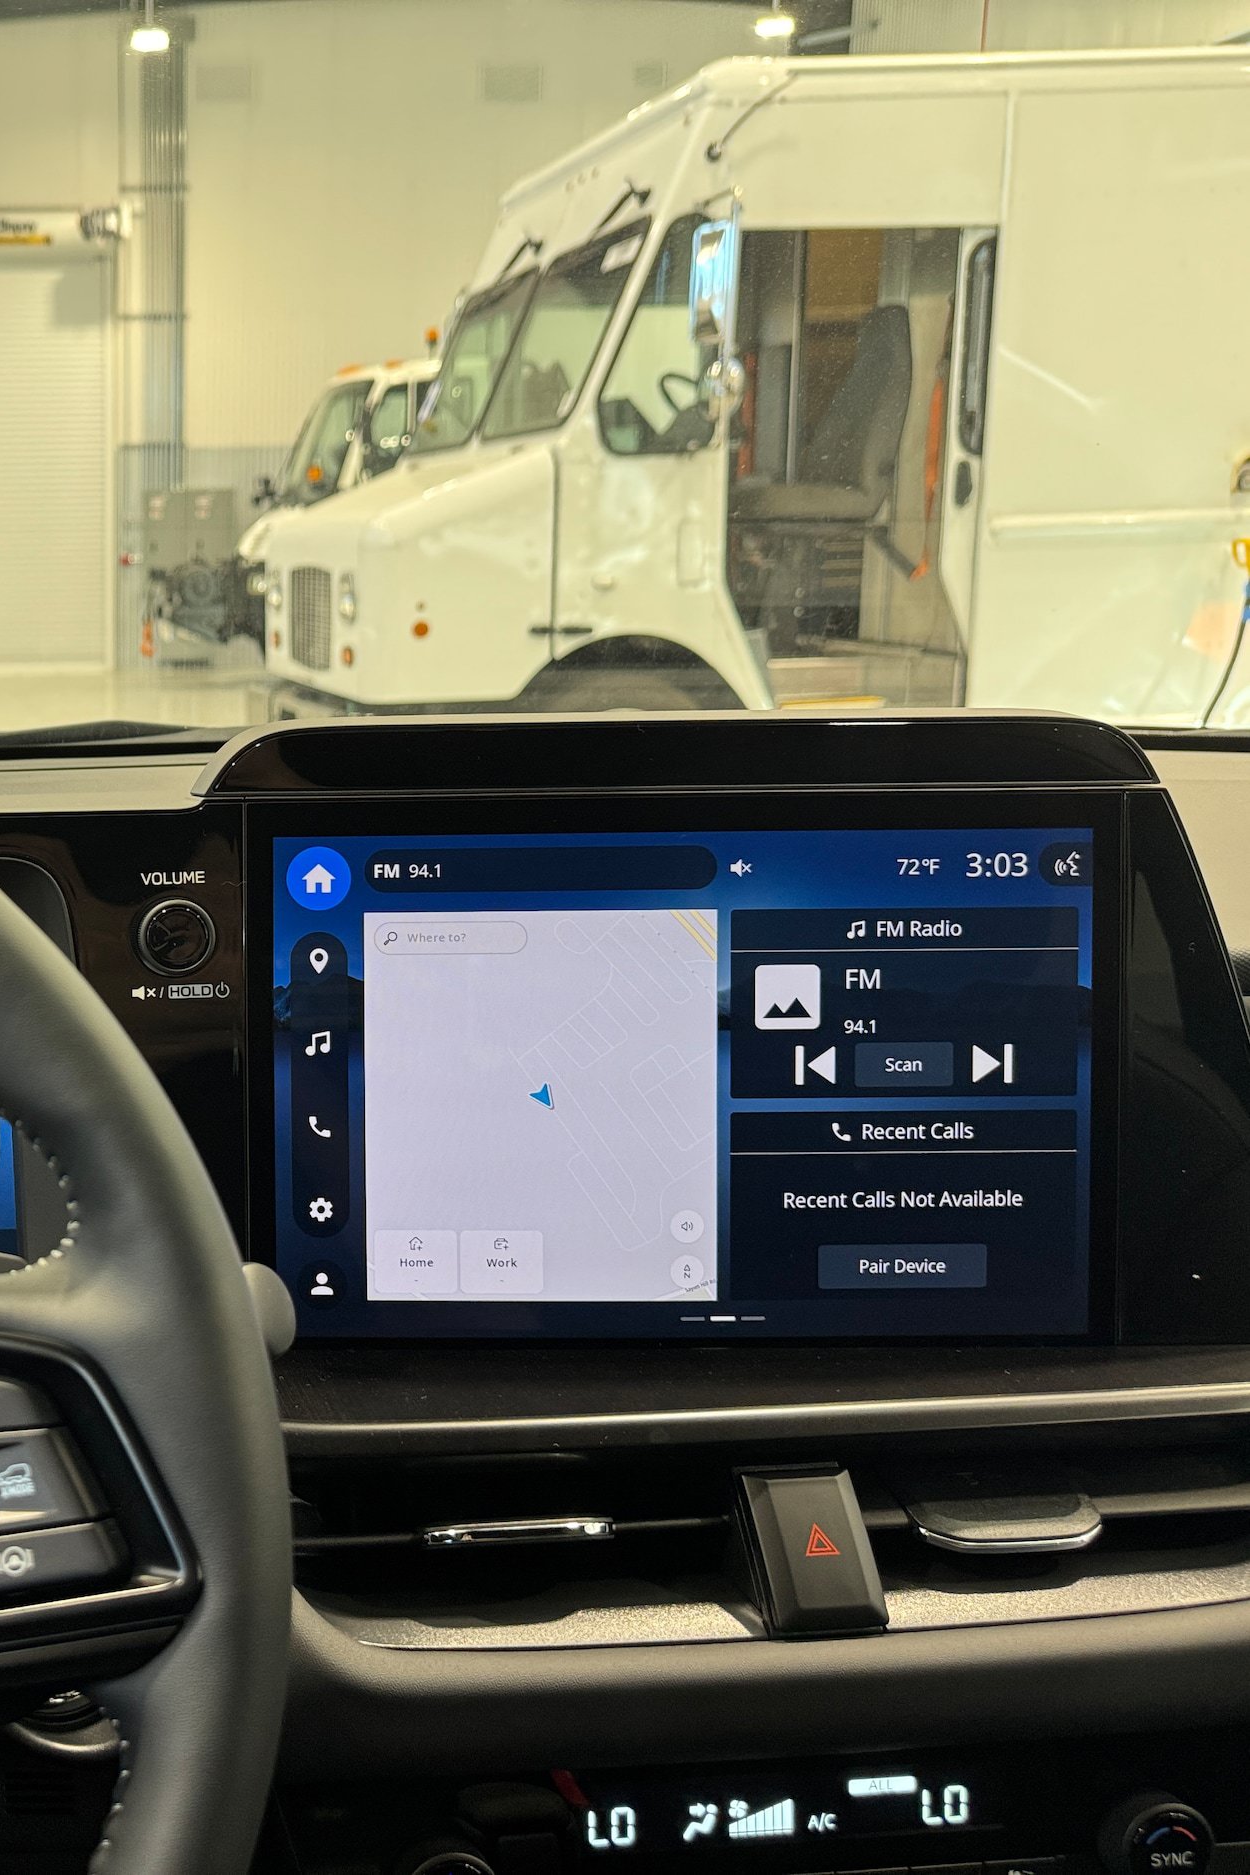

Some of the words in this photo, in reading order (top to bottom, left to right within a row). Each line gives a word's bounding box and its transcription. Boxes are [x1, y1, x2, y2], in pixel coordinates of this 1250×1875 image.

[374, 863, 400, 878] FM
[408, 863, 442, 879] 94.1
[896, 858, 941, 876] 72°F
[965, 852, 1029, 878] 3:03
[140, 870, 206, 886] VOLUME
[876, 921, 904, 938] FM
[910, 920, 963, 938] Radio
[406, 932, 445, 944] Where
[449, 932, 467, 943] to?
[845, 968, 882, 991] FM
[169, 985, 212, 998] HOLD
[843, 1019, 877, 1035] 94.1
[884, 1057, 923, 1073] Scan
[861, 1123, 927, 1140] Recent
[930, 1121, 975, 1140] Calls
[783, 1192, 848, 1209] Recent
[851, 1190, 896, 1209] Calls
[900, 1191, 936, 1209] Not
[938, 1189, 1024, 1208] Available
[399, 1257, 434, 1269] Home
[486, 1257, 518, 1269] Work
[858, 1259, 890, 1275] Pair
[894, 1258, 947, 1274] Device
[867, 1779, 893, 1792] ALL
[921, 1783, 969, 1826] LO
[587, 1806, 637, 1849] LO
[807, 1812, 838, 1833] A/C
[1150, 1850, 1196, 1869] SYNC
